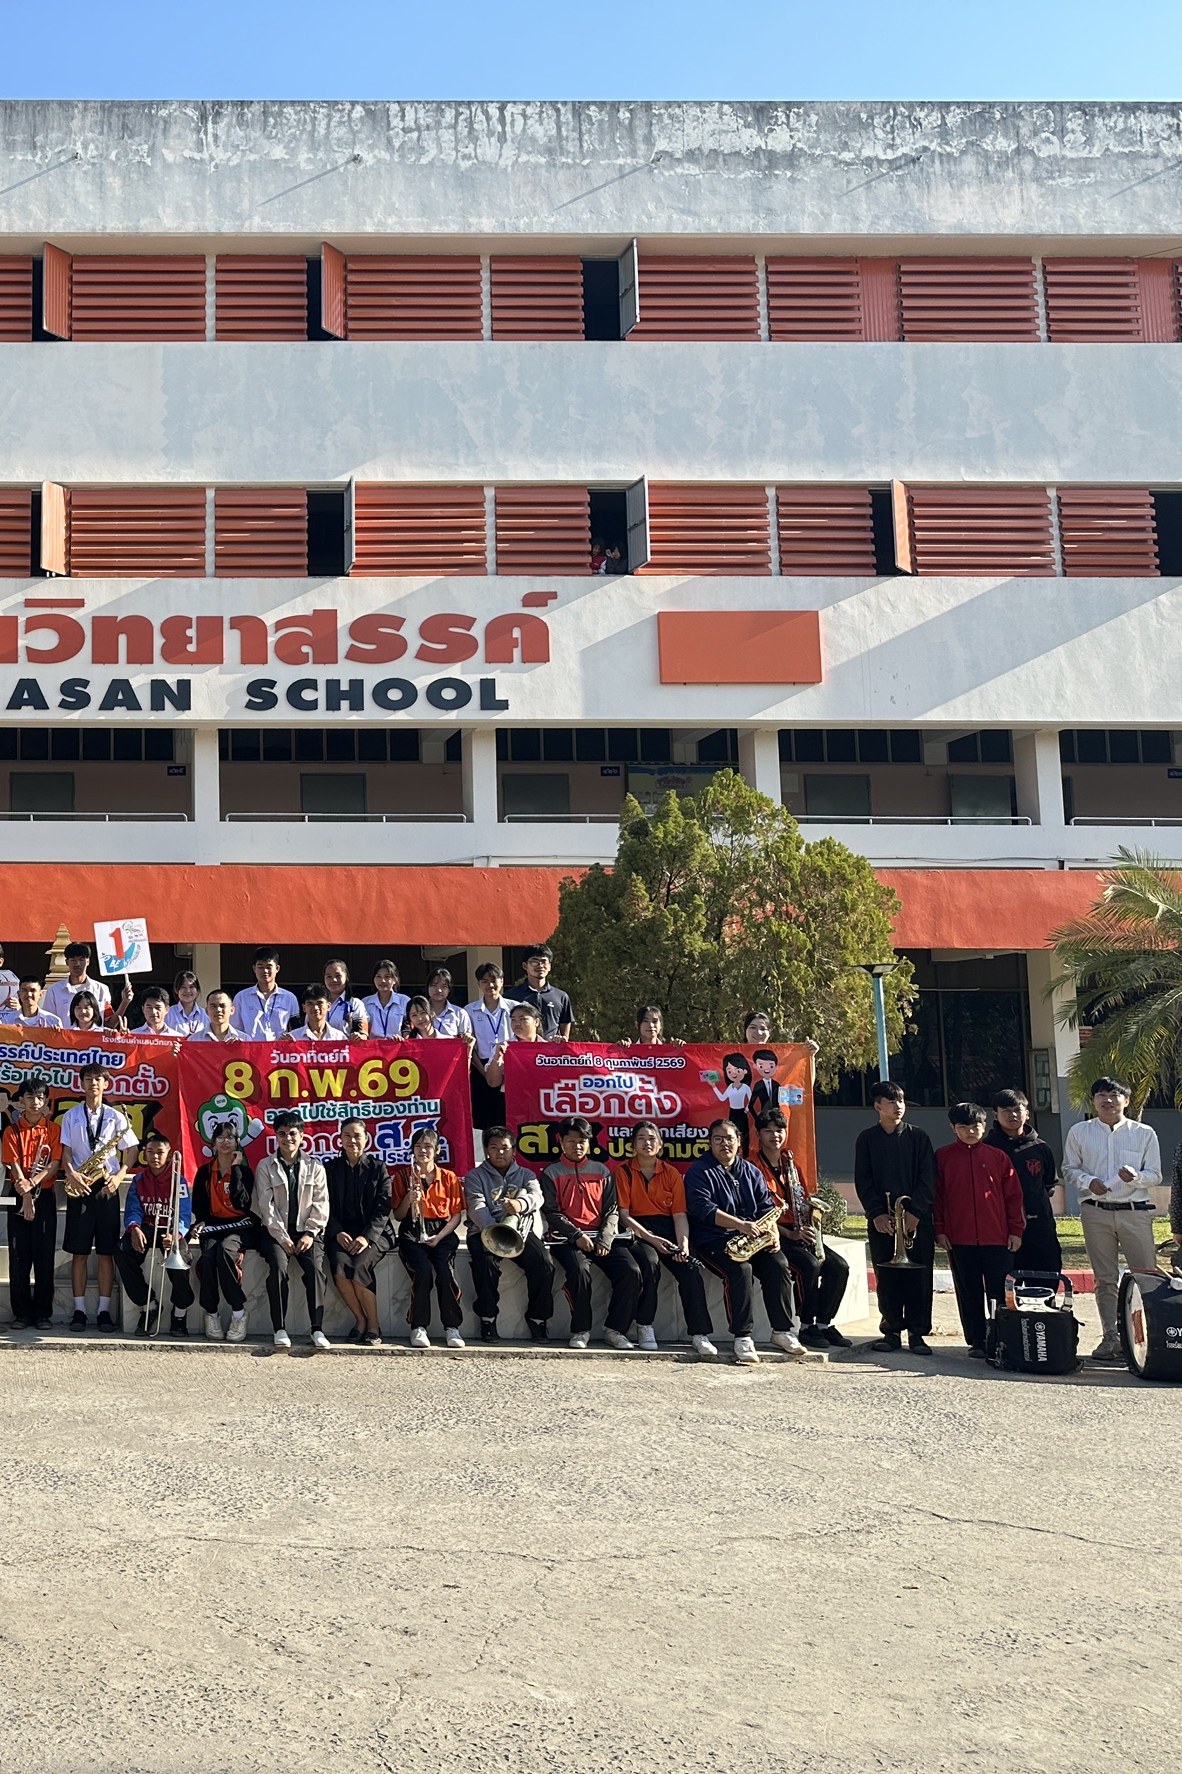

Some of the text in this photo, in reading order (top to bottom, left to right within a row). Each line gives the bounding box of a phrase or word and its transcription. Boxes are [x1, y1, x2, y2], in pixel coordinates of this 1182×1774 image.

[244, 677, 510, 713] SCHOOL
[108, 927, 125, 959] 1
[270, 1045, 351, 1064] วันอาทิตย์ที่
[536, 1053, 686, 1070] วันอาทิตย์ที่ 8 กุมภาพันธ์ 2569
[223, 1058, 421, 1100] 8 ก.พ.69
[582, 1075, 634, 1090] ออกไป
[540, 1077, 680, 1117] เลือกตั้ง
[1035, 1331, 1048, 1362] YAMAHA
